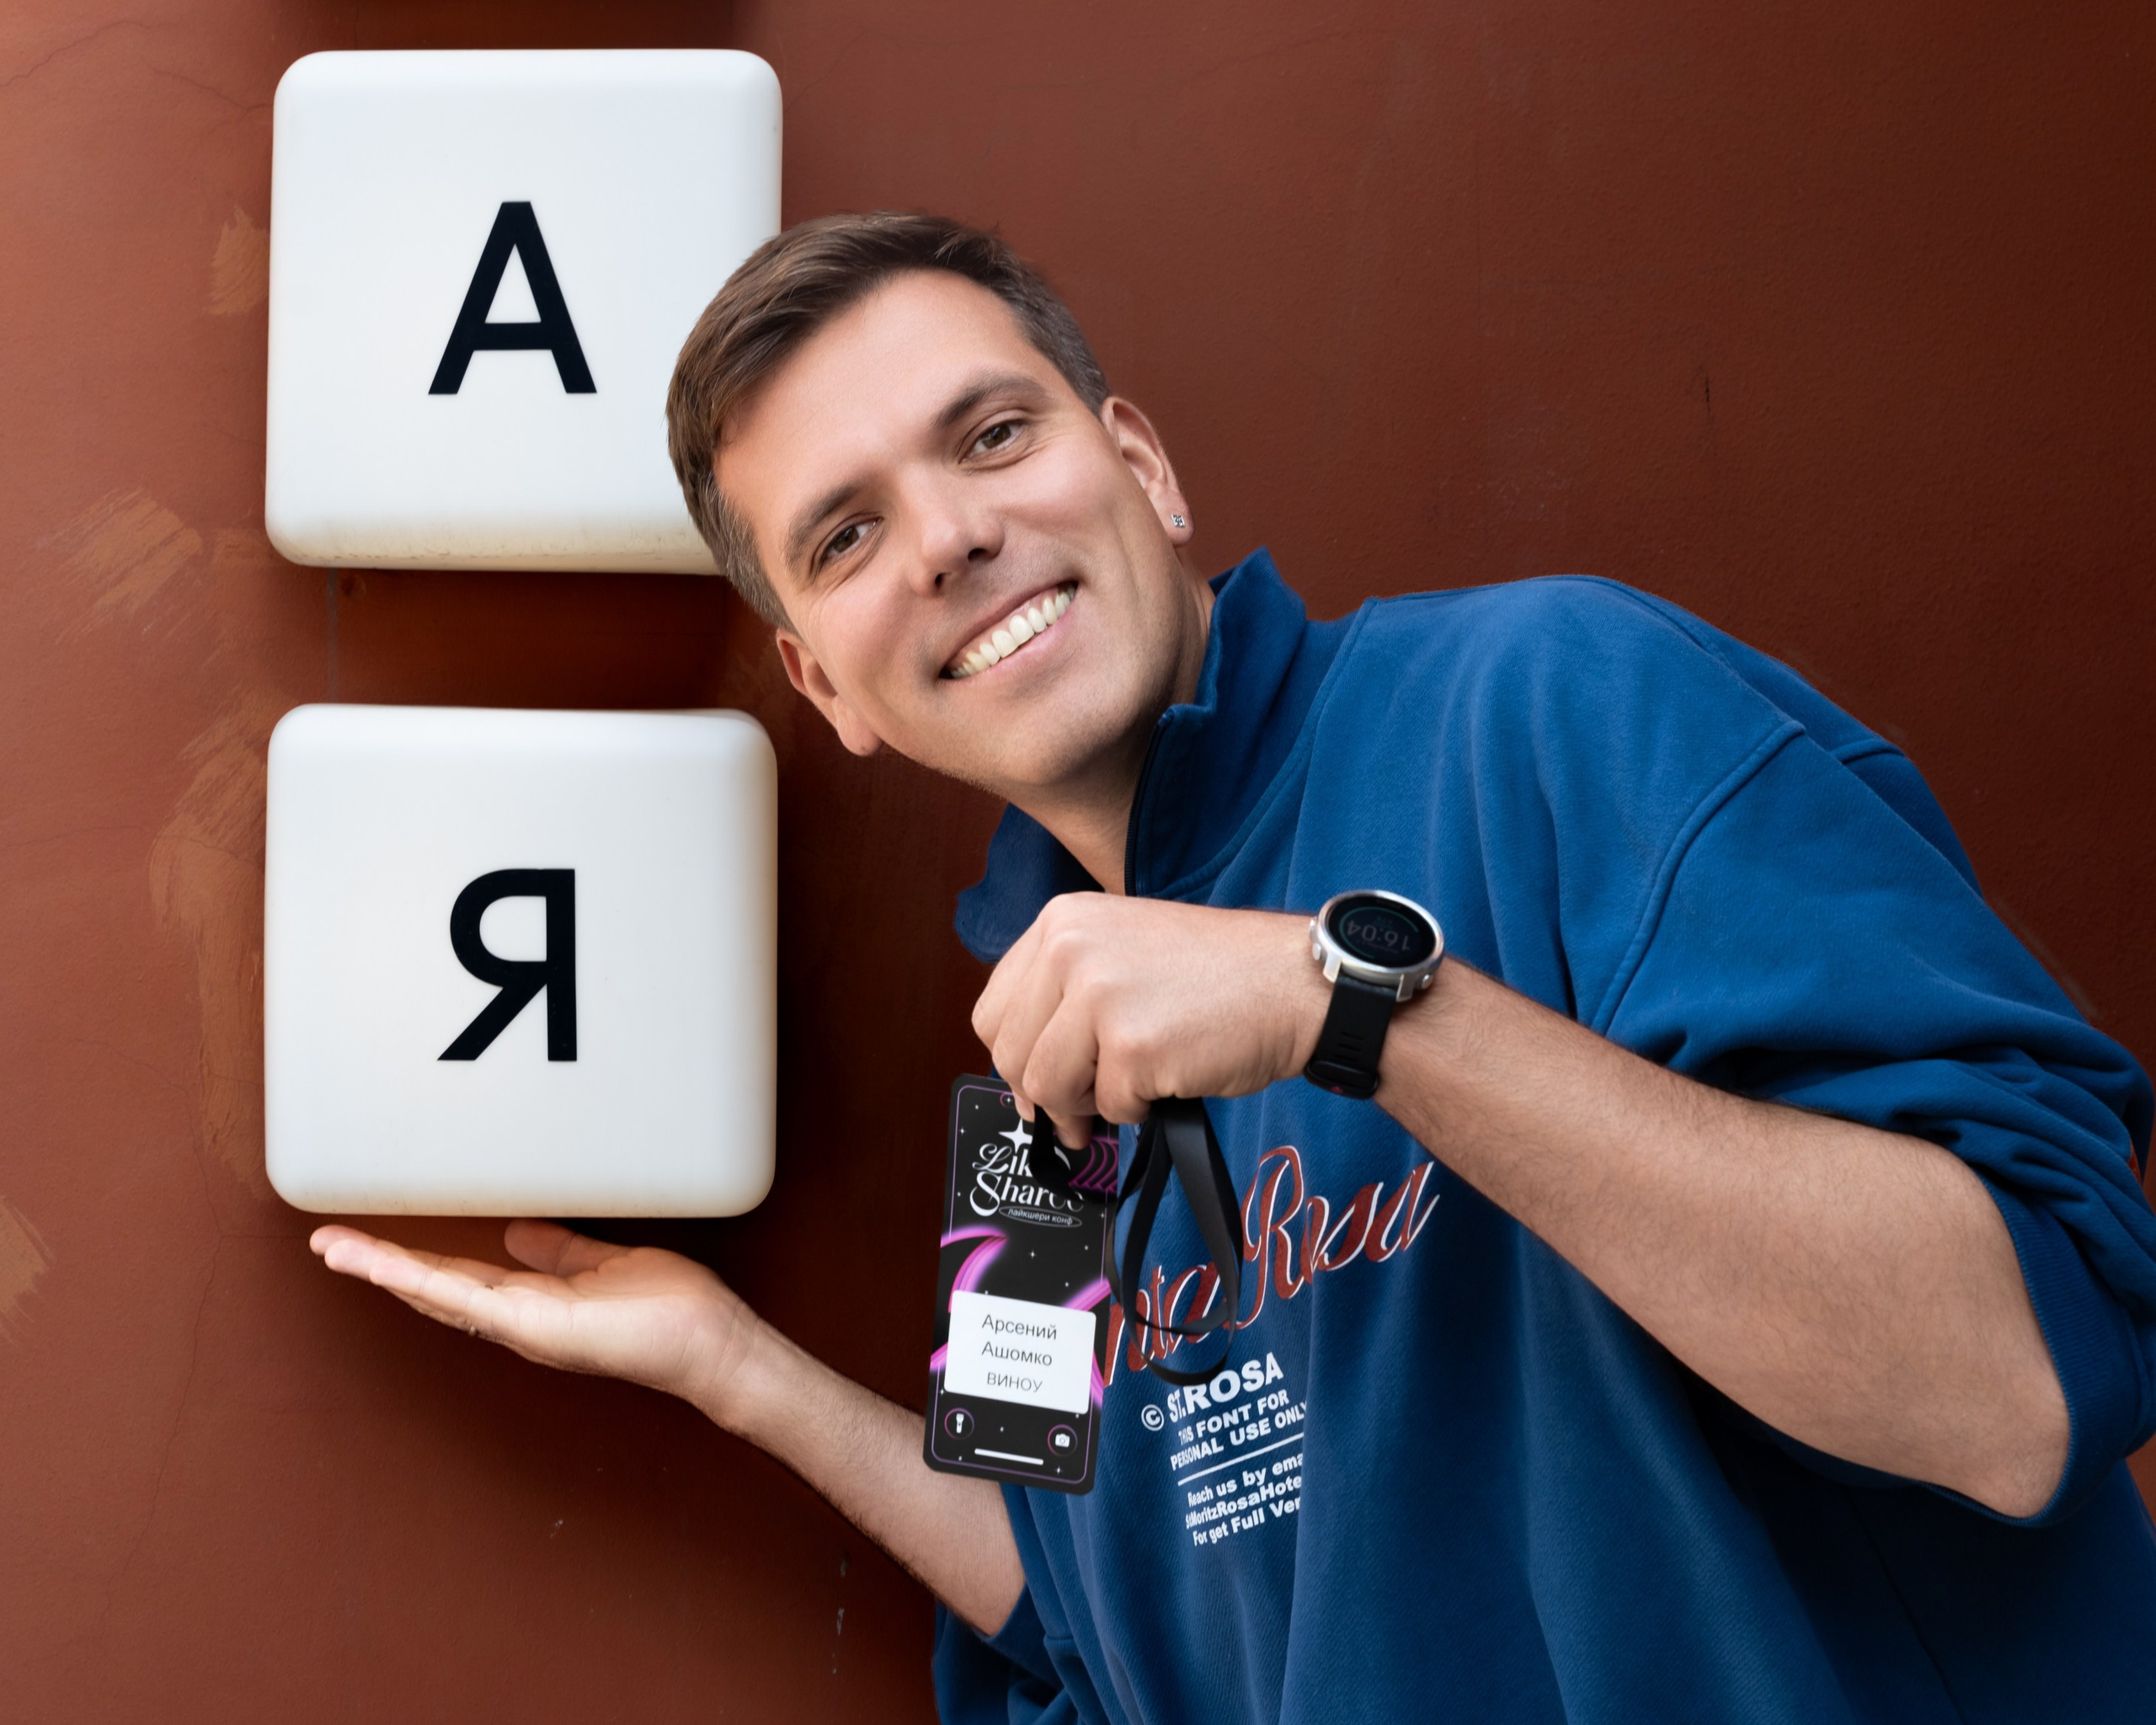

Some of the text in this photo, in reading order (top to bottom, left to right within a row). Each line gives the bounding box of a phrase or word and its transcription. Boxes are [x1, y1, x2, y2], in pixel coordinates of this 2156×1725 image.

[1347, 919, 1411, 952] 16:04
[436, 868, 578, 1062] Я
[972, 1143, 1033, 1178] Lik
[1052, 1215, 1073, 1226] конф
[981, 1314, 1058, 1341] Арсений
[981, 1341, 1053, 1367] Ашомко
[986, 1371, 1043, 1393] ВИНОУ
[1178, 1389, 1289, 1446] THIS FONT FOR
[1170, 1437, 1225, 1471] PERSONAL
[1230, 1417, 1272, 1446] USE
[1187, 1485, 1214, 1509] Reach
[1216, 1479, 1238, 1498] us
[1242, 1467, 1267, 1487] by
[1193, 1530, 1208, 1547] For
[1209, 1521, 1230, 1545] get
[1230, 1507, 1266, 1534] Full
